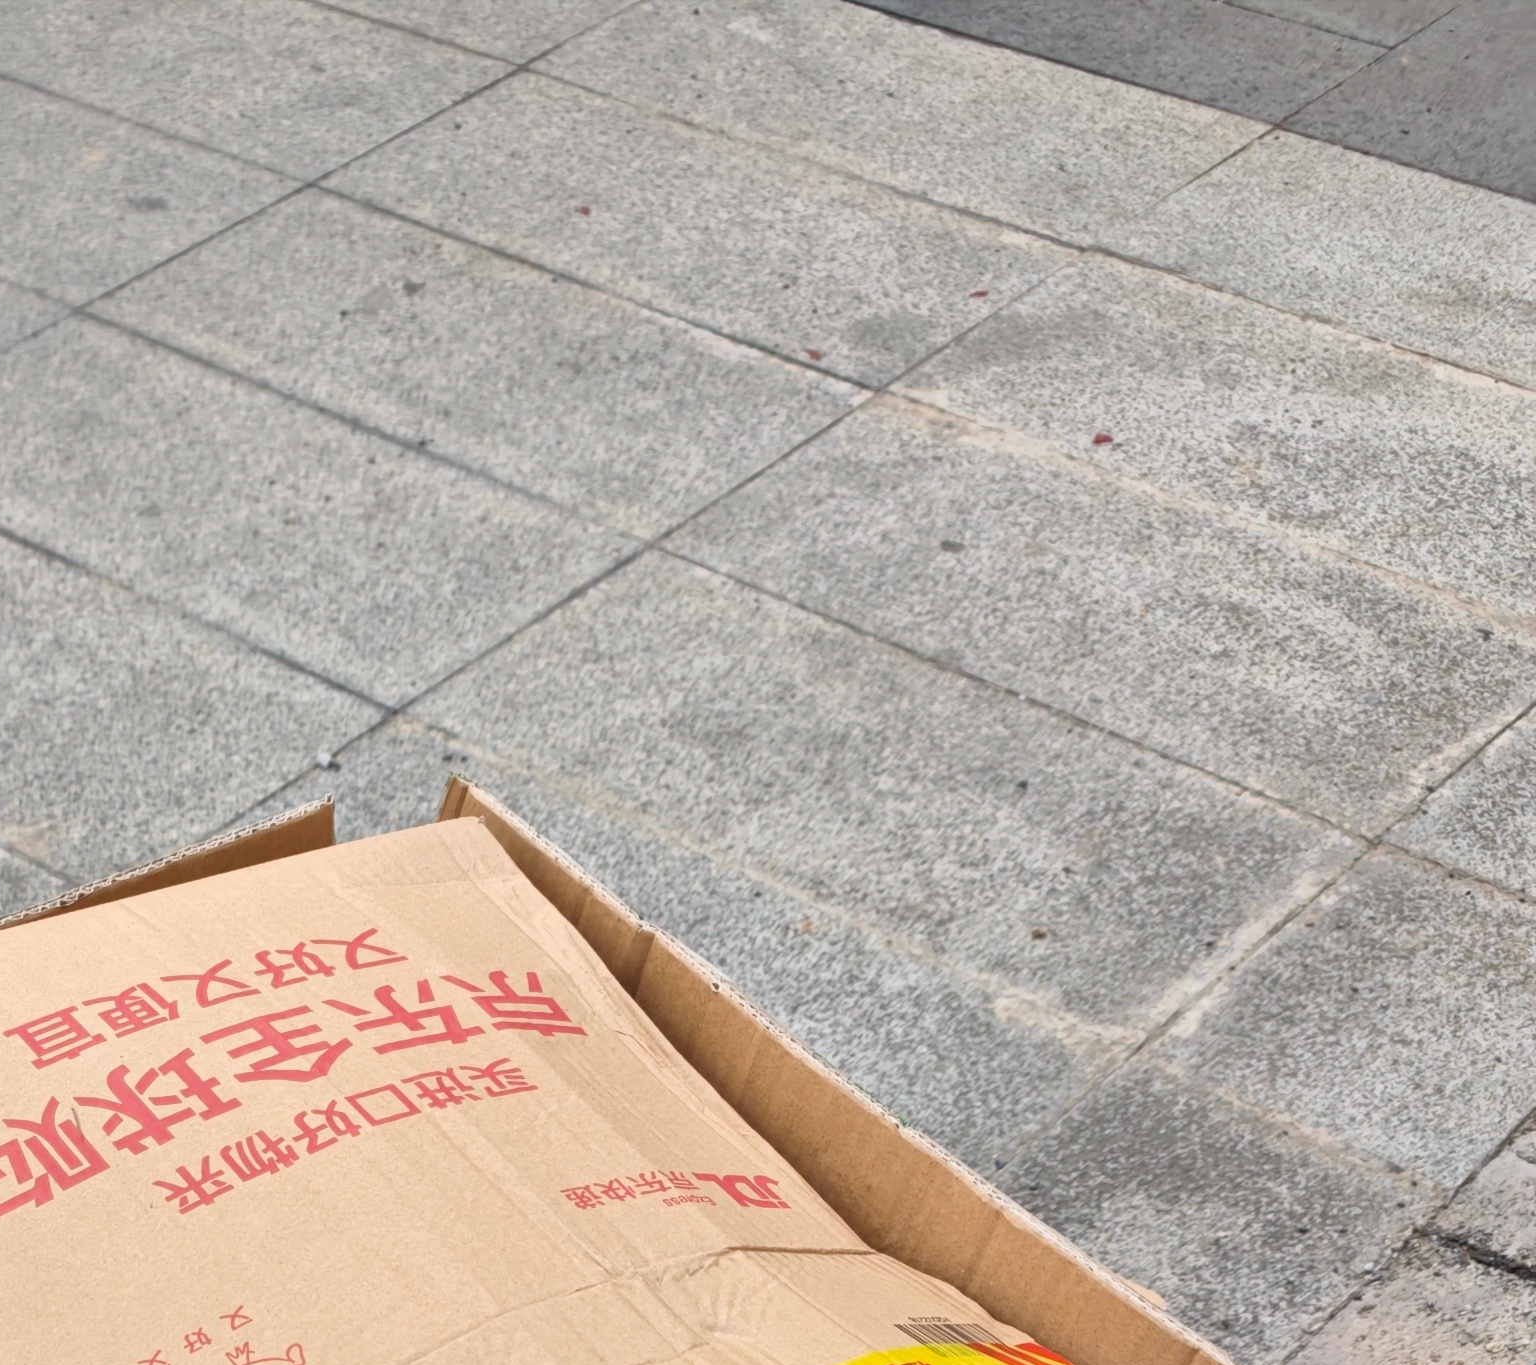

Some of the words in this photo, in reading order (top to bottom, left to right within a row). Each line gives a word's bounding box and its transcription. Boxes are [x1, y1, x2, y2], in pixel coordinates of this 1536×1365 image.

[2, 927, 411, 1070] 又好又便宜
[151, 1058, 540, 1215] 买进口好物来
[559, 1171, 697, 1213] 京东快递
